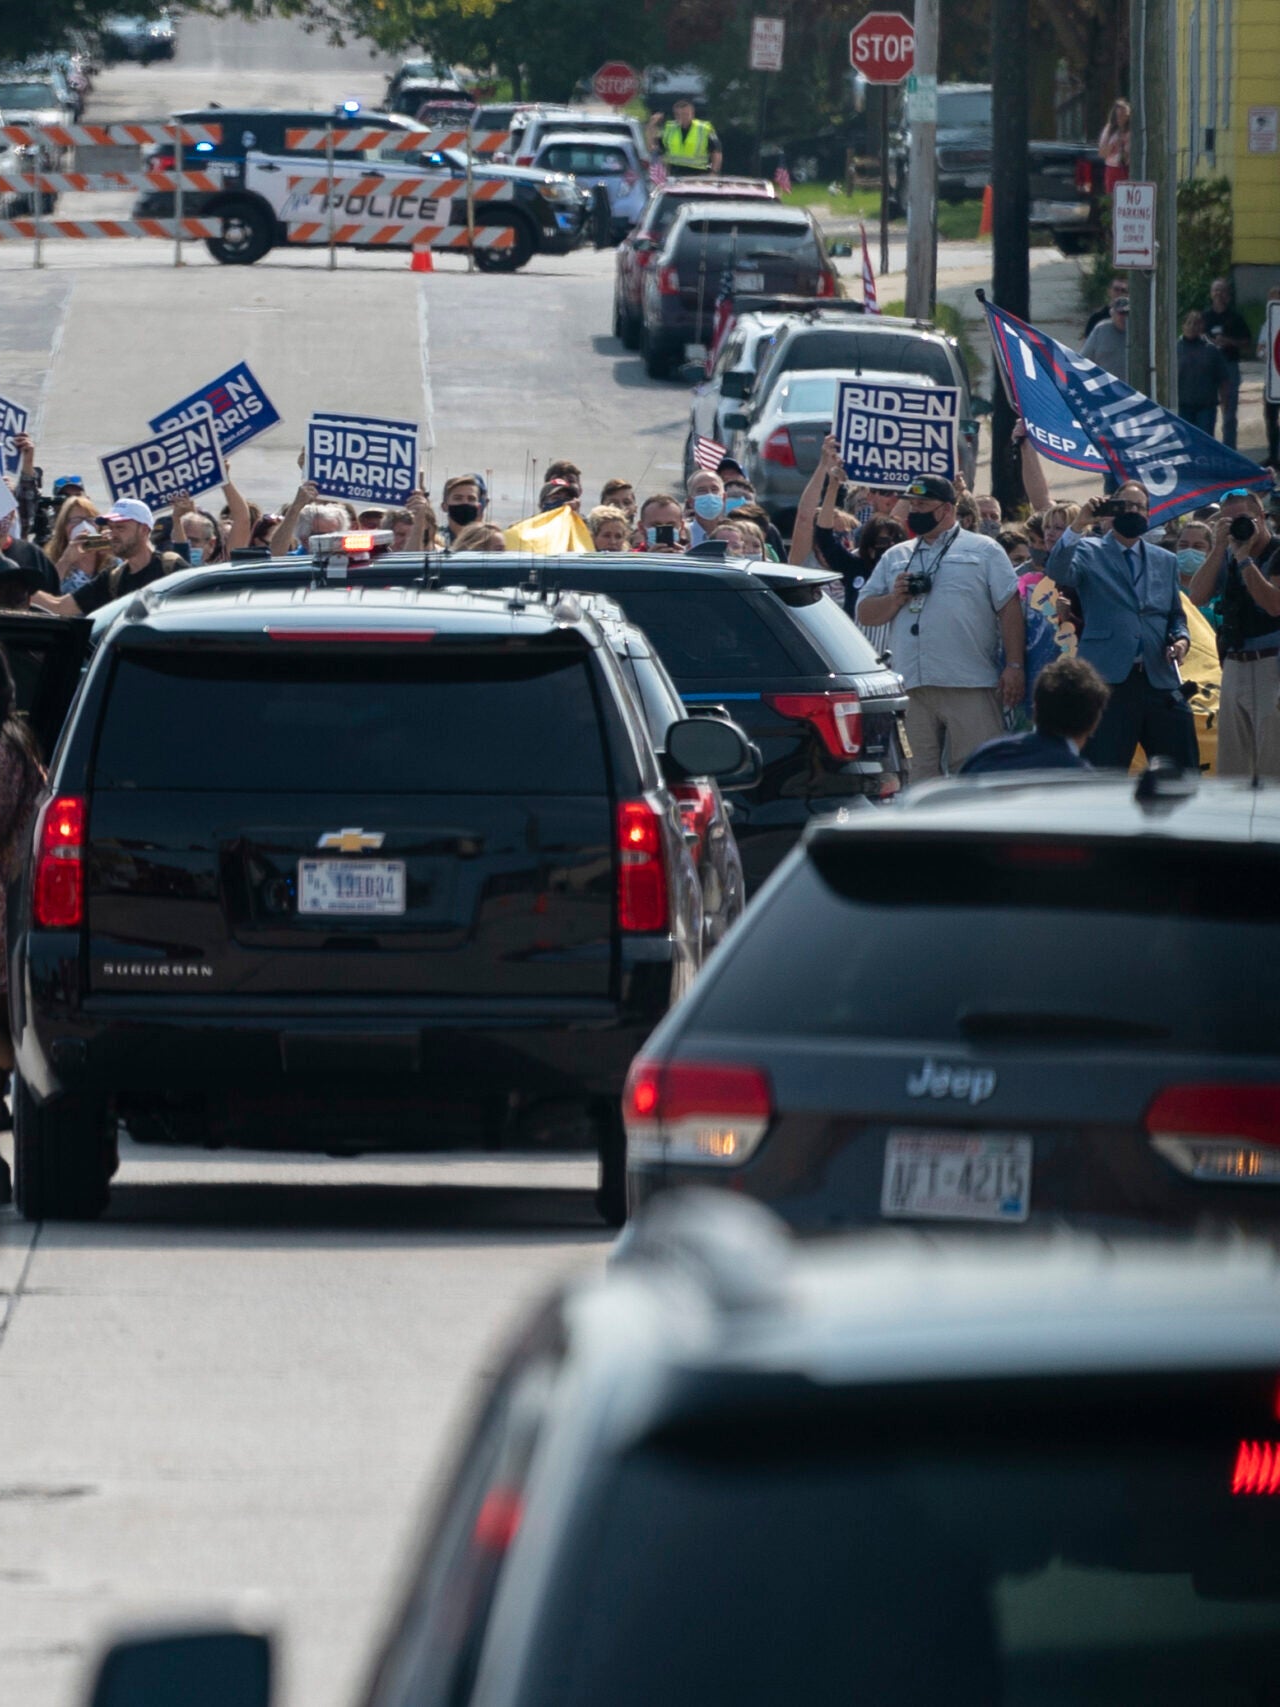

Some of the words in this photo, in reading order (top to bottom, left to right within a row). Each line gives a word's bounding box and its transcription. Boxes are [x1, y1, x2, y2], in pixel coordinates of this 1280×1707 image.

[855, 34, 914, 62] STOP
[324, 193, 439, 220] POLICE
[1126, 189, 1142, 205] NO
[1118, 207, 1151, 219] PARKING
[843, 387, 951, 416] BIDEN
[848, 413, 949, 450] BIDEN
[1024, 419, 1077, 452] KEEP
[107, 424, 211, 485] BIDEN
[313, 429, 412, 467] BIDEN
[847, 442, 949, 473] HARRIS
[117, 452, 215, 500] HARRIS
[313, 457, 411, 490] HARRIS
[883, 471, 910, 481] 2020
[347, 485, 373, 497] 2020
[104, 965, 213, 977] SUBURBAN
[907, 1057, 997, 1104] Jeep
